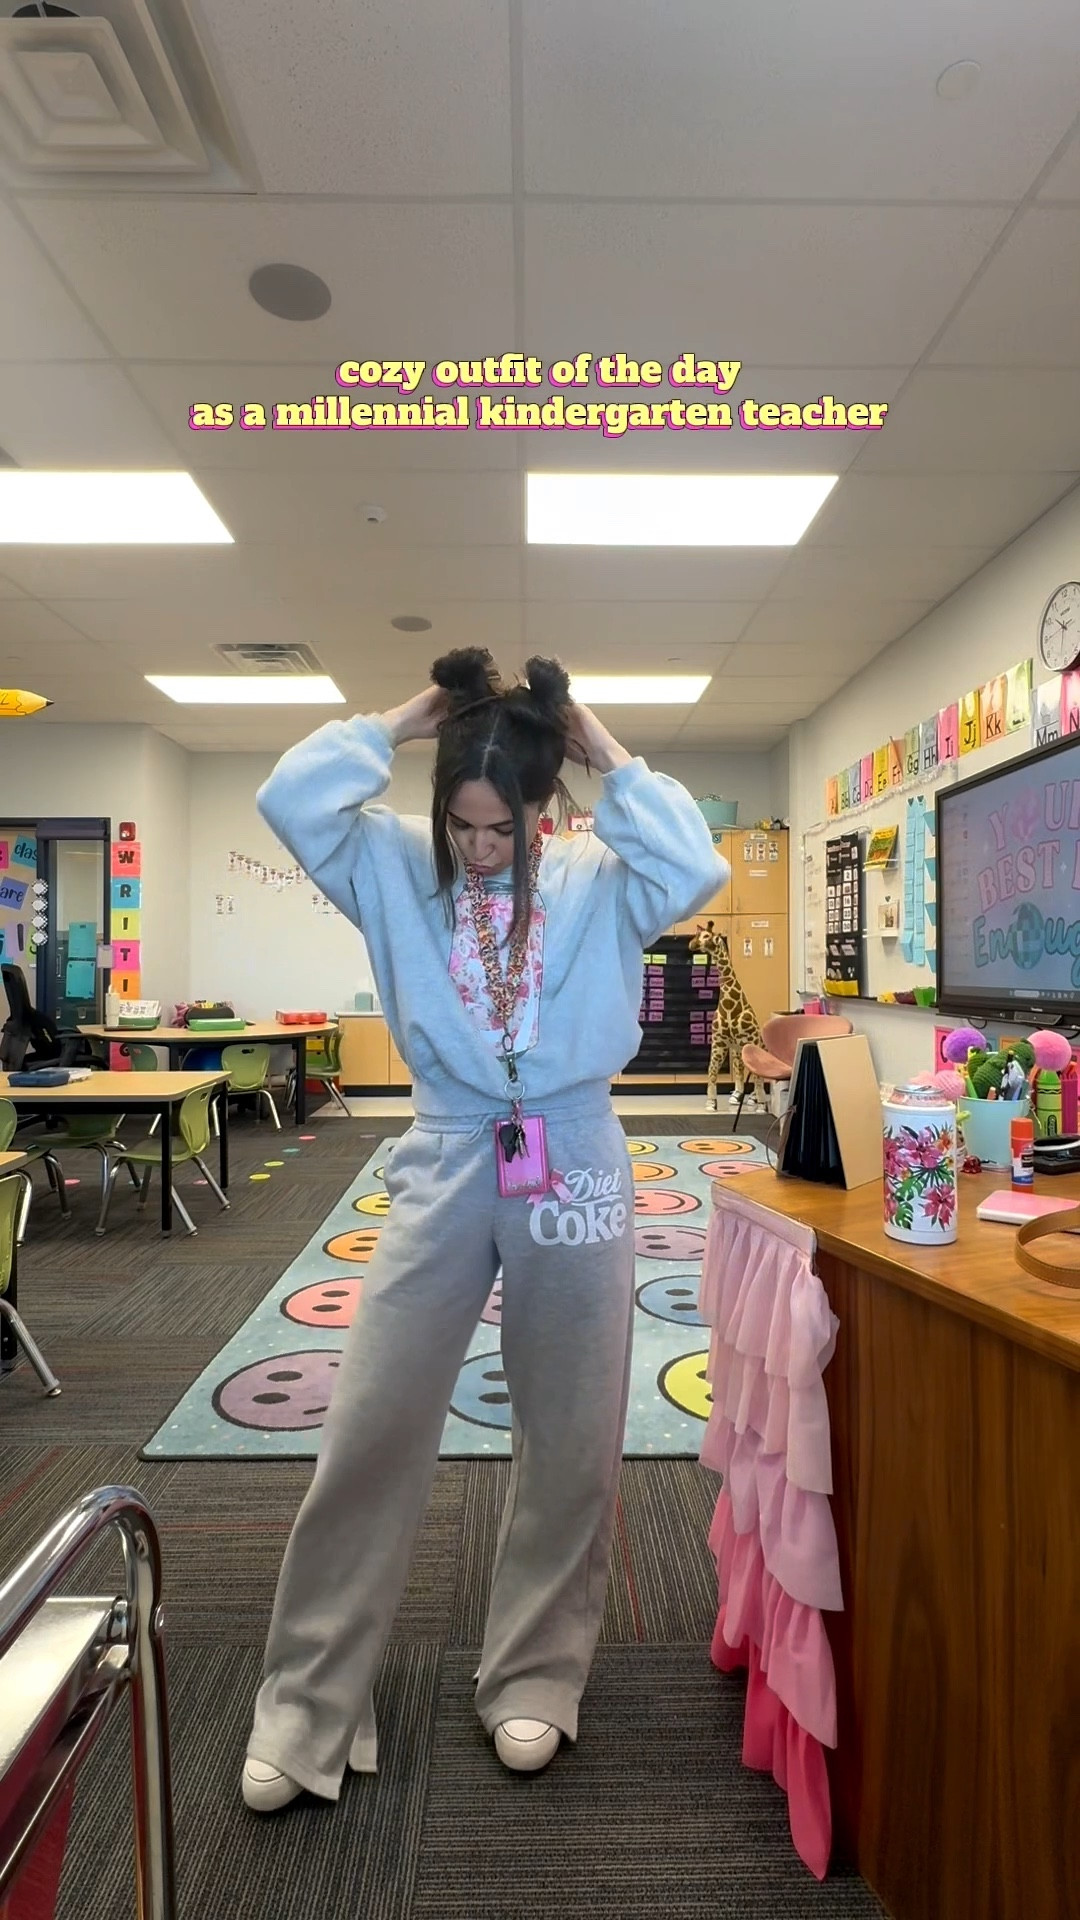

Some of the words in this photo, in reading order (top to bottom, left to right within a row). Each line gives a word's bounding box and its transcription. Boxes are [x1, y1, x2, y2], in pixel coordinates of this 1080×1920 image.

[964, 720, 976, 748] Jj
[986, 713, 1002, 739] Kk
[907, 754, 919, 775] Gg
[976, 838, 1062, 914] BEST
[564, 1167, 622, 1202] Diet
[529, 1200, 627, 1246] Coke
